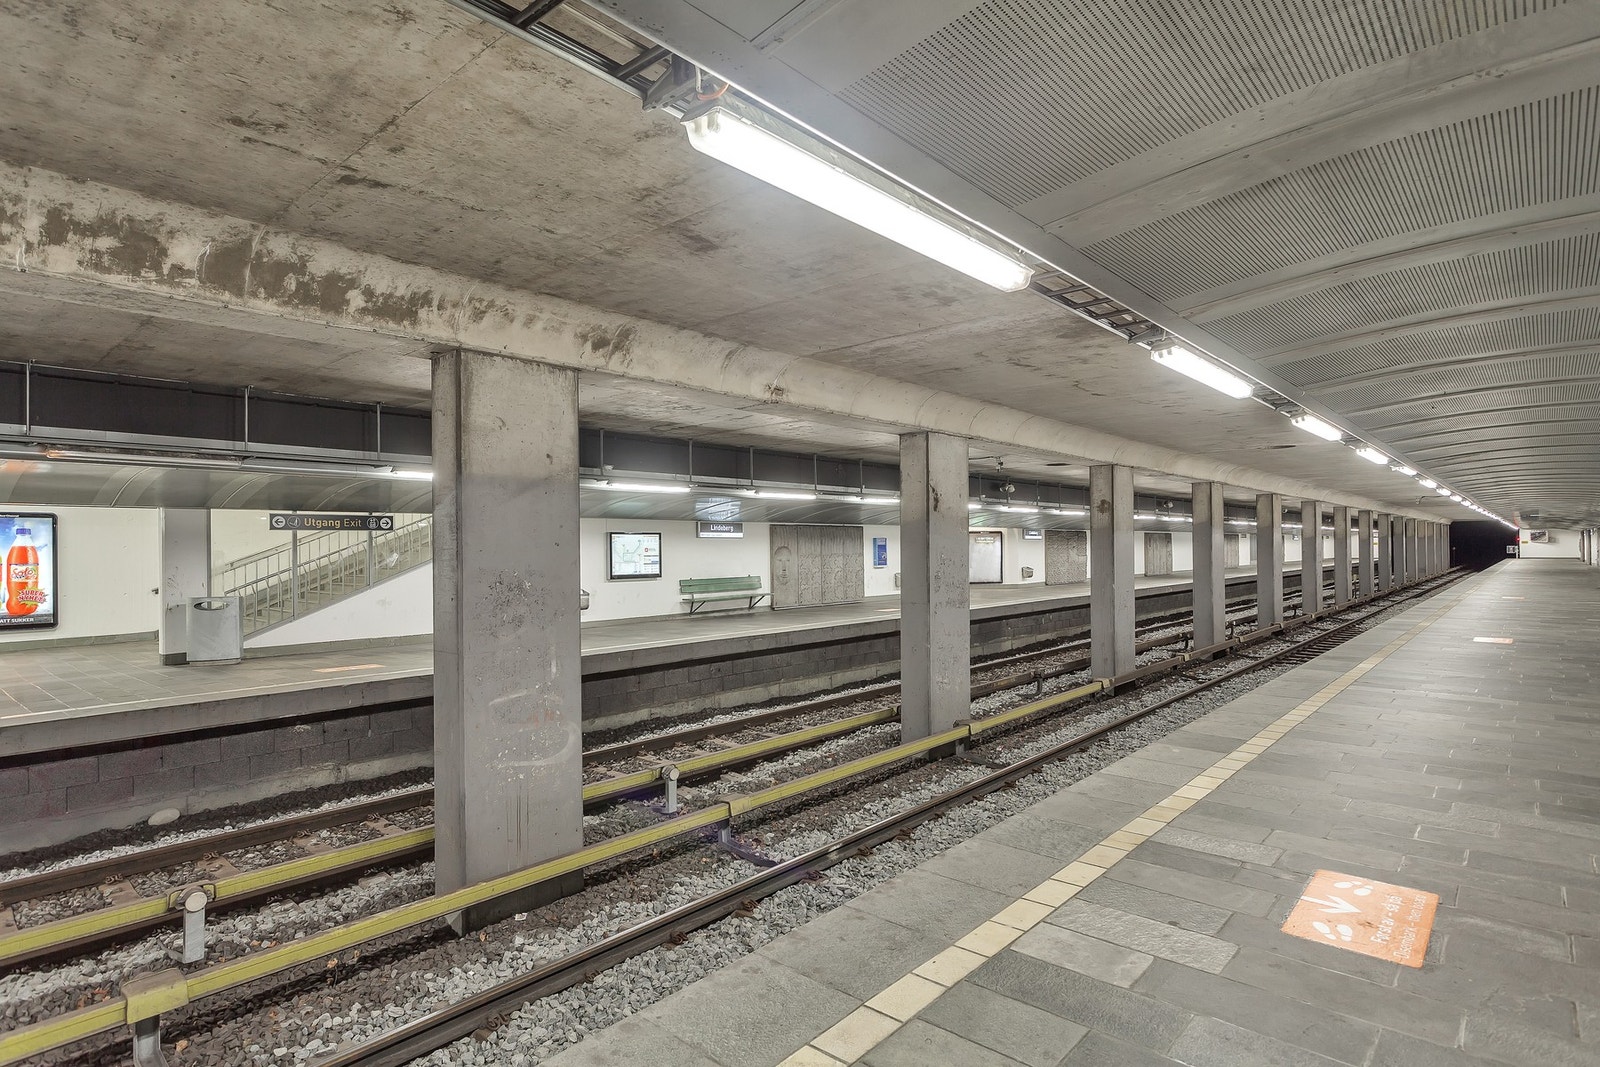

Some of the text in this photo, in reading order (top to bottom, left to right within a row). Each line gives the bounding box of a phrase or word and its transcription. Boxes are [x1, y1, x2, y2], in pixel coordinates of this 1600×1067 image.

[304, 518, 361, 528] Utgang Exit
[710, 524, 734, 532] Lindeberg
[20, 589, 44, 597] SUPER
